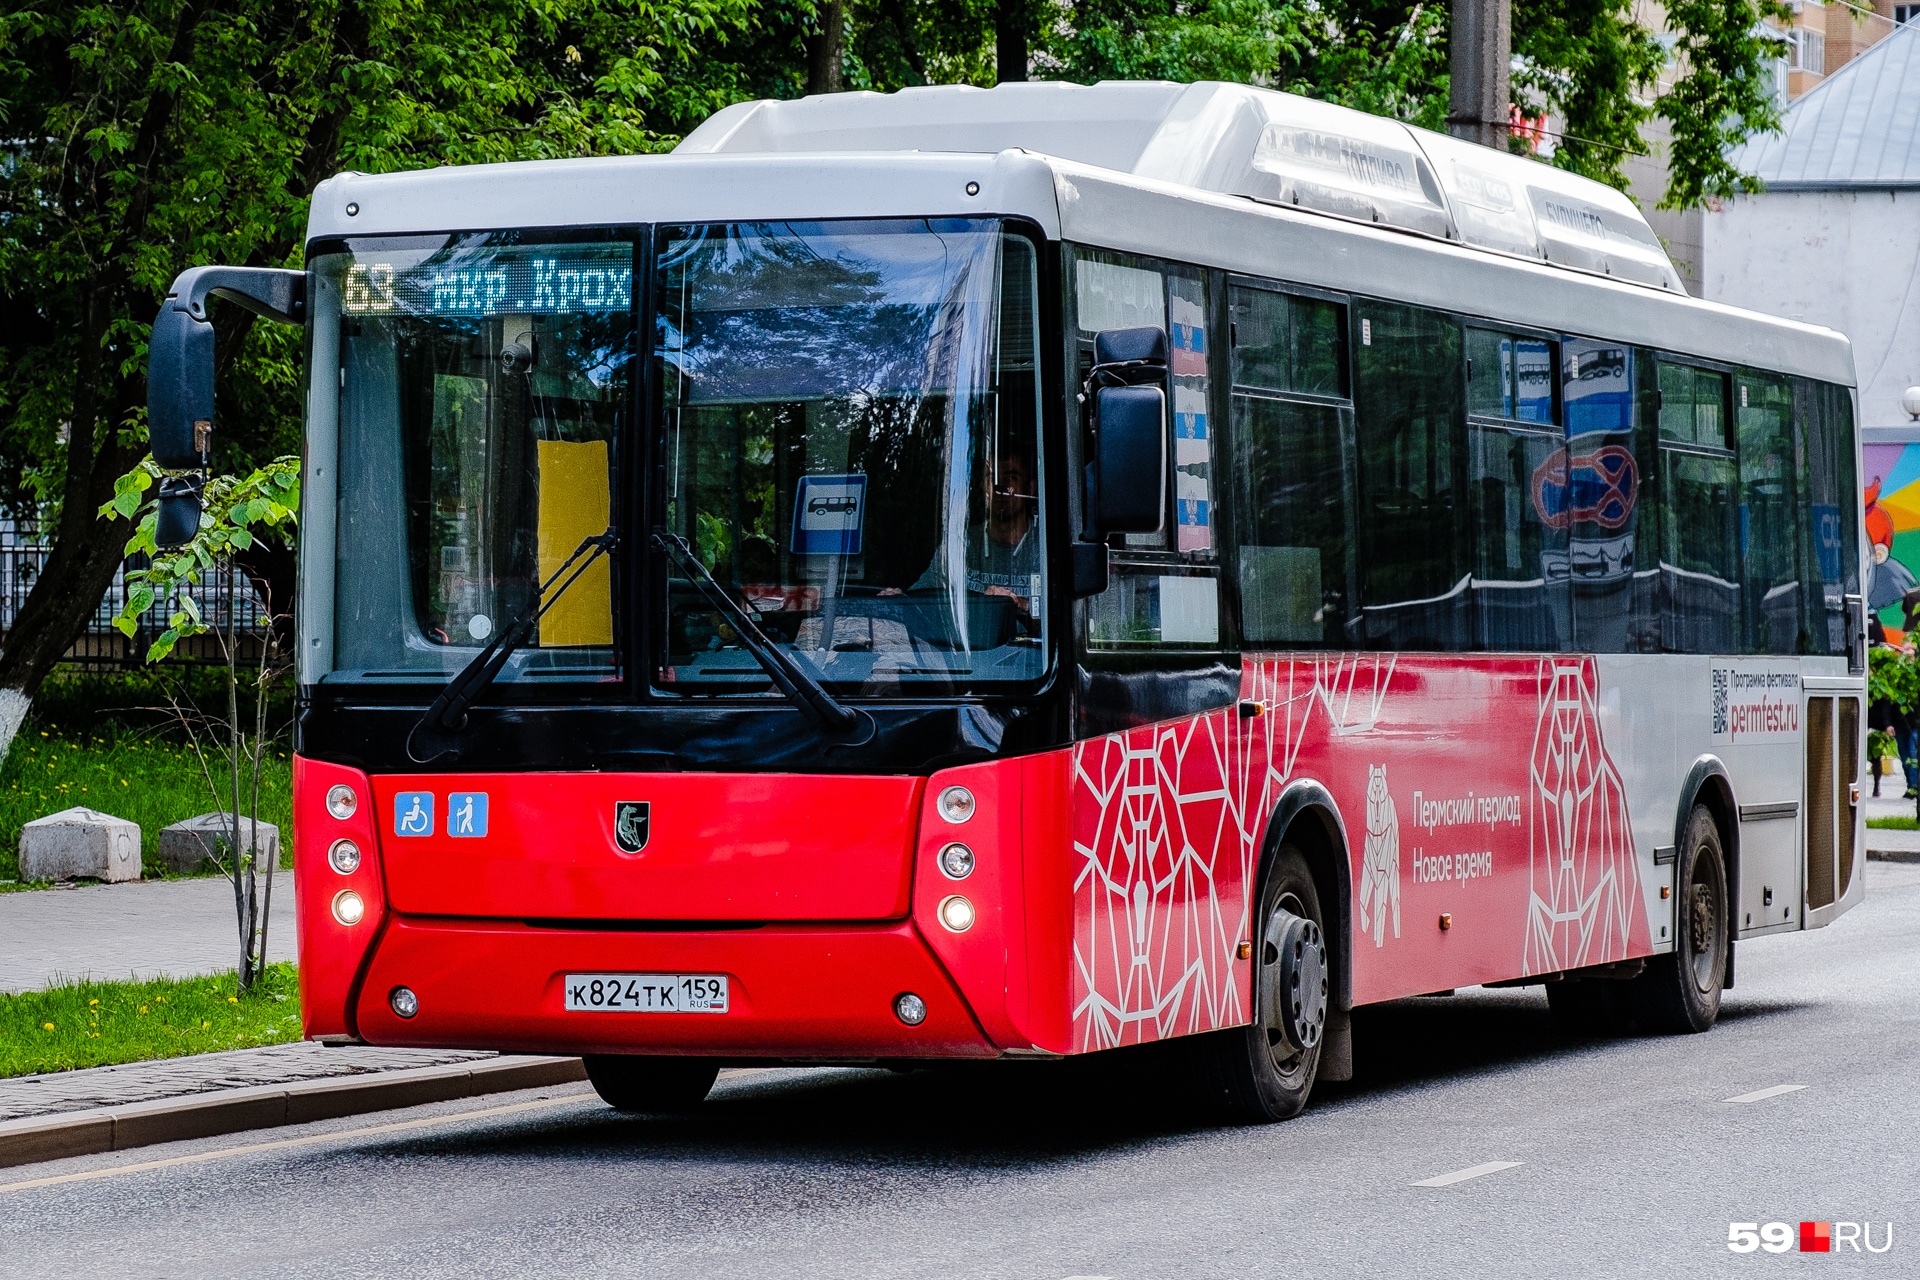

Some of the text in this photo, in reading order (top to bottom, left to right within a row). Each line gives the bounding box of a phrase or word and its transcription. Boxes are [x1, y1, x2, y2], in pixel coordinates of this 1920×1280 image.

[346, 263, 394, 311] 63
[1732, 669, 1798, 692] Программа фестиваля
[1731, 694, 1798, 743] permfest.ru
[1413, 791, 1521, 836] Пермский период
[1413, 847, 1492, 888] Новое время
[681, 979, 721, 999] 159
[689, 1000, 709, 1008] RUS
